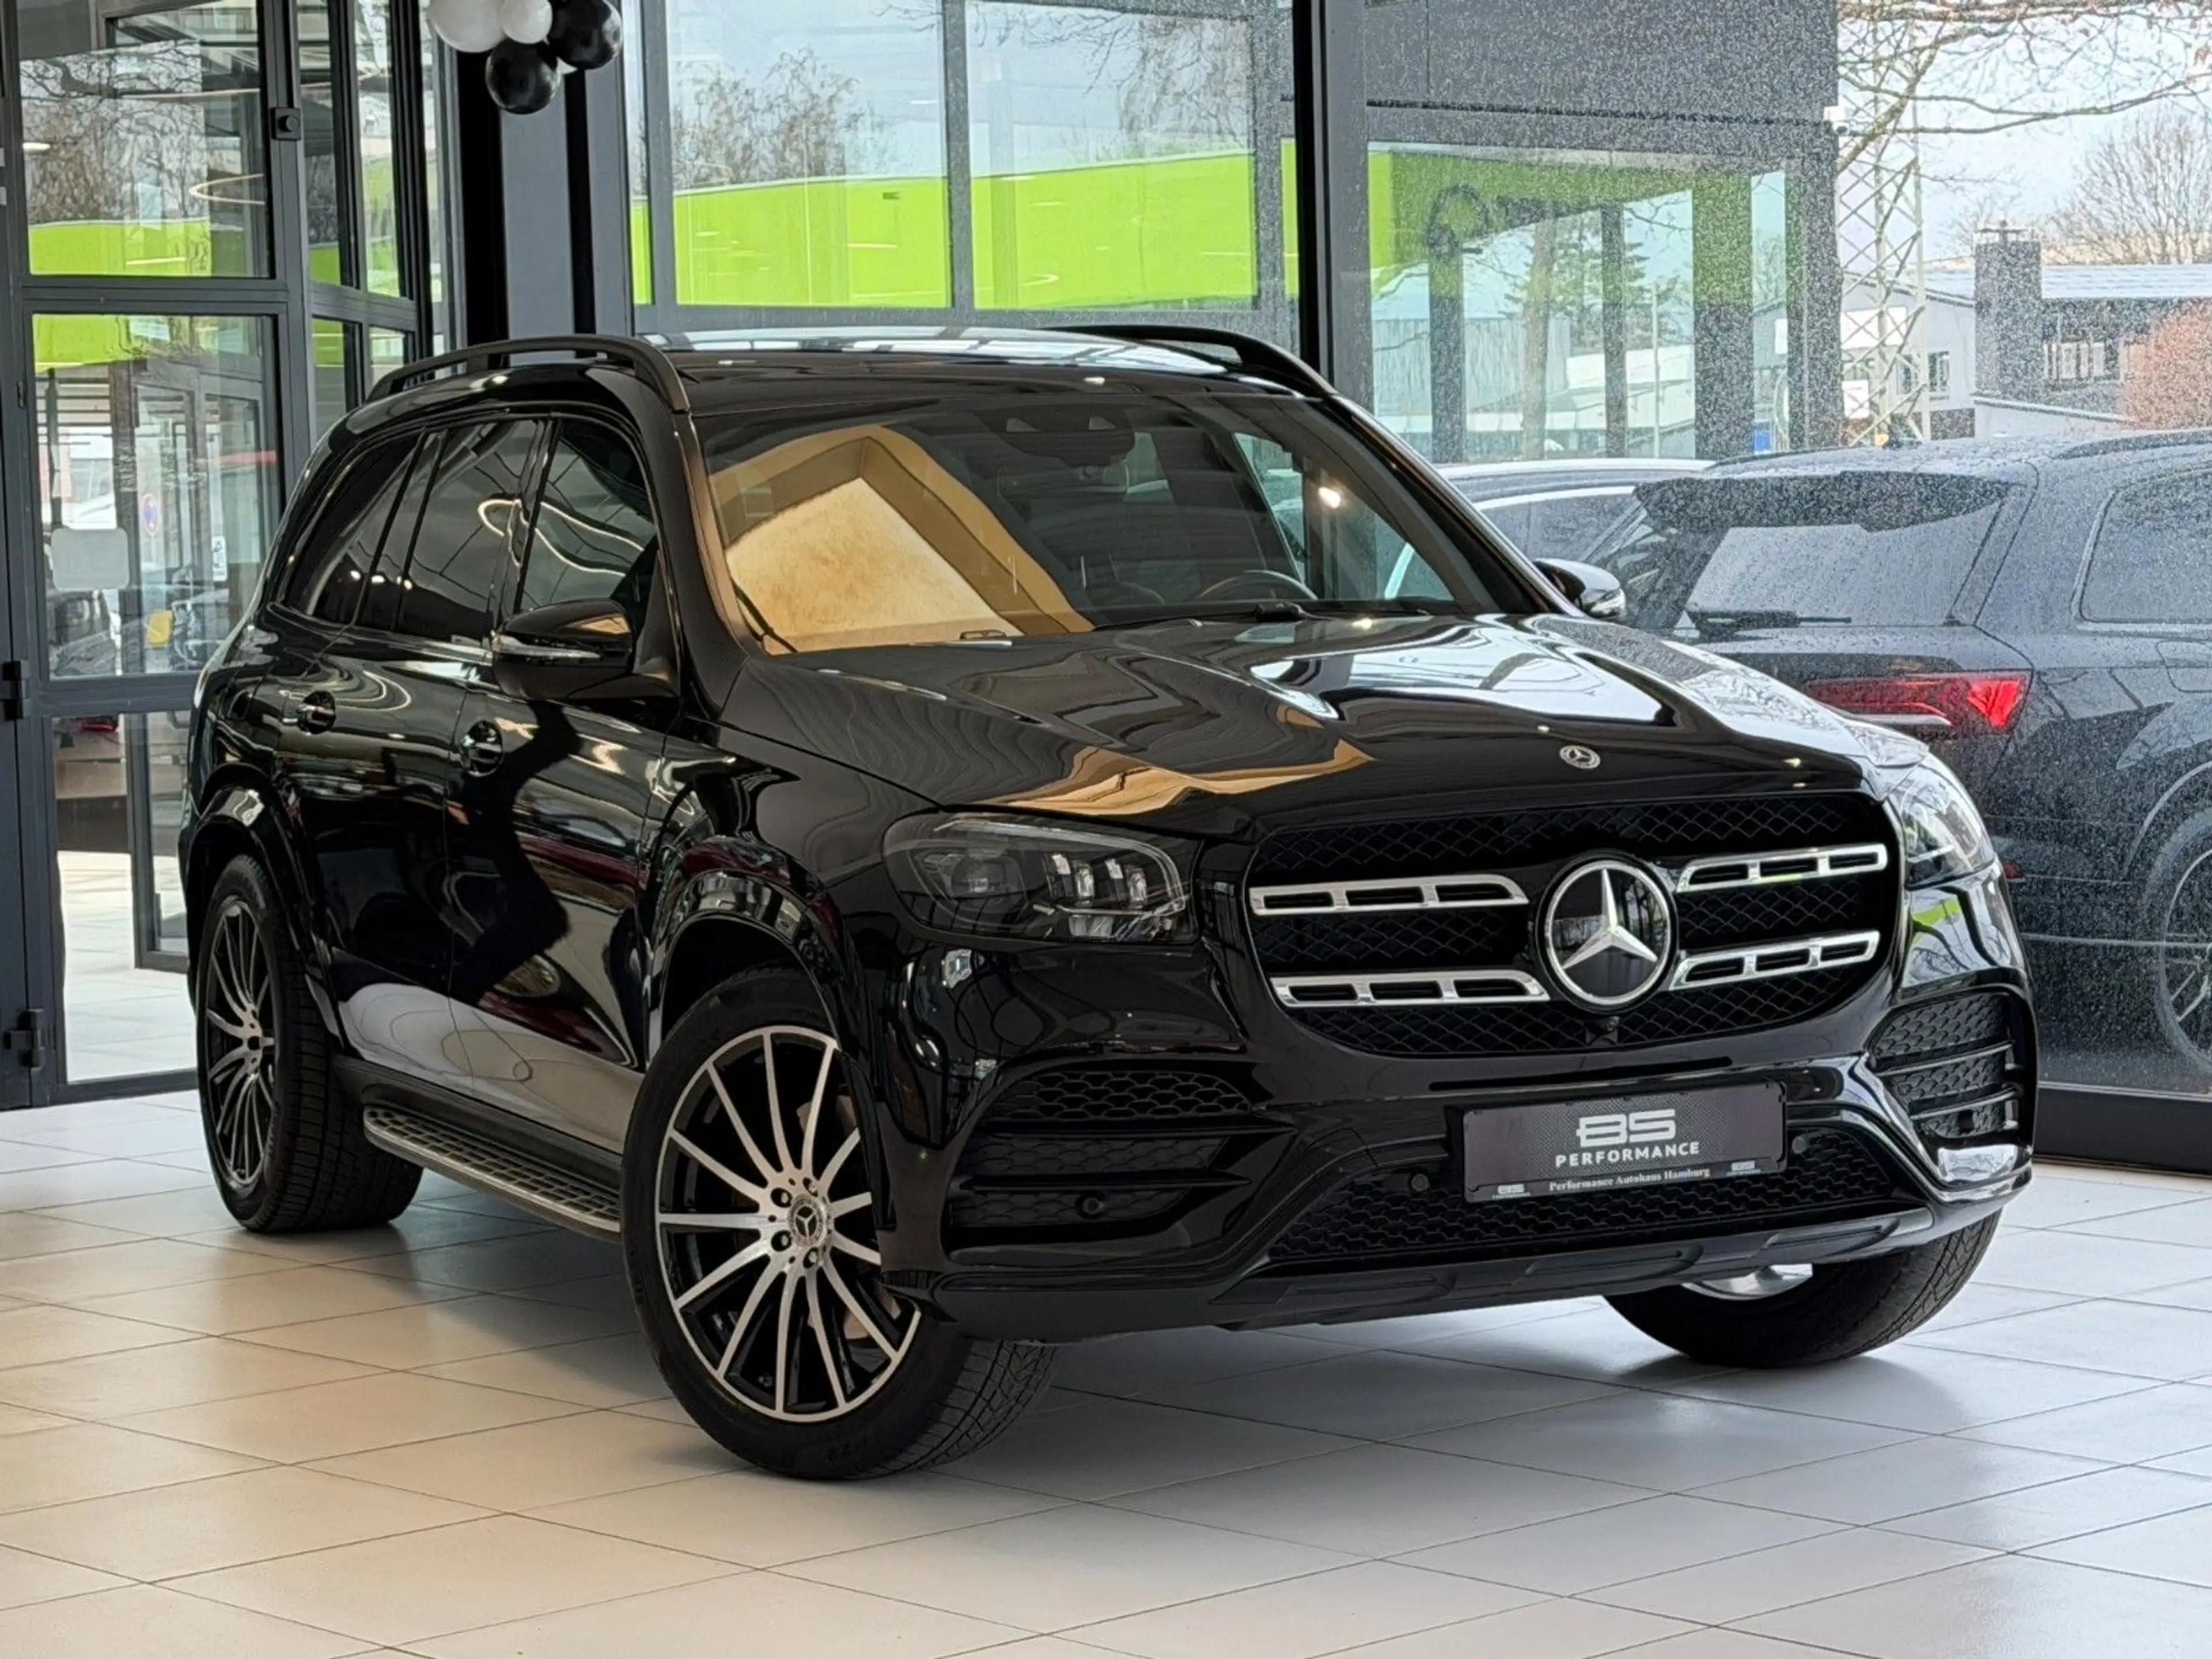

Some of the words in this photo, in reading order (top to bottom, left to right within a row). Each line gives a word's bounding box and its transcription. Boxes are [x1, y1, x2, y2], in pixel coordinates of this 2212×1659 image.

[1576, 1109, 1676, 1147] BS
[1555, 1141, 1699, 1168] PERFORMANCE
[1549, 1178, 1613, 1191] Performance
[1615, 1173, 1661, 1185] Autohaus
[1664, 1168, 1710, 1180] Hamburg
